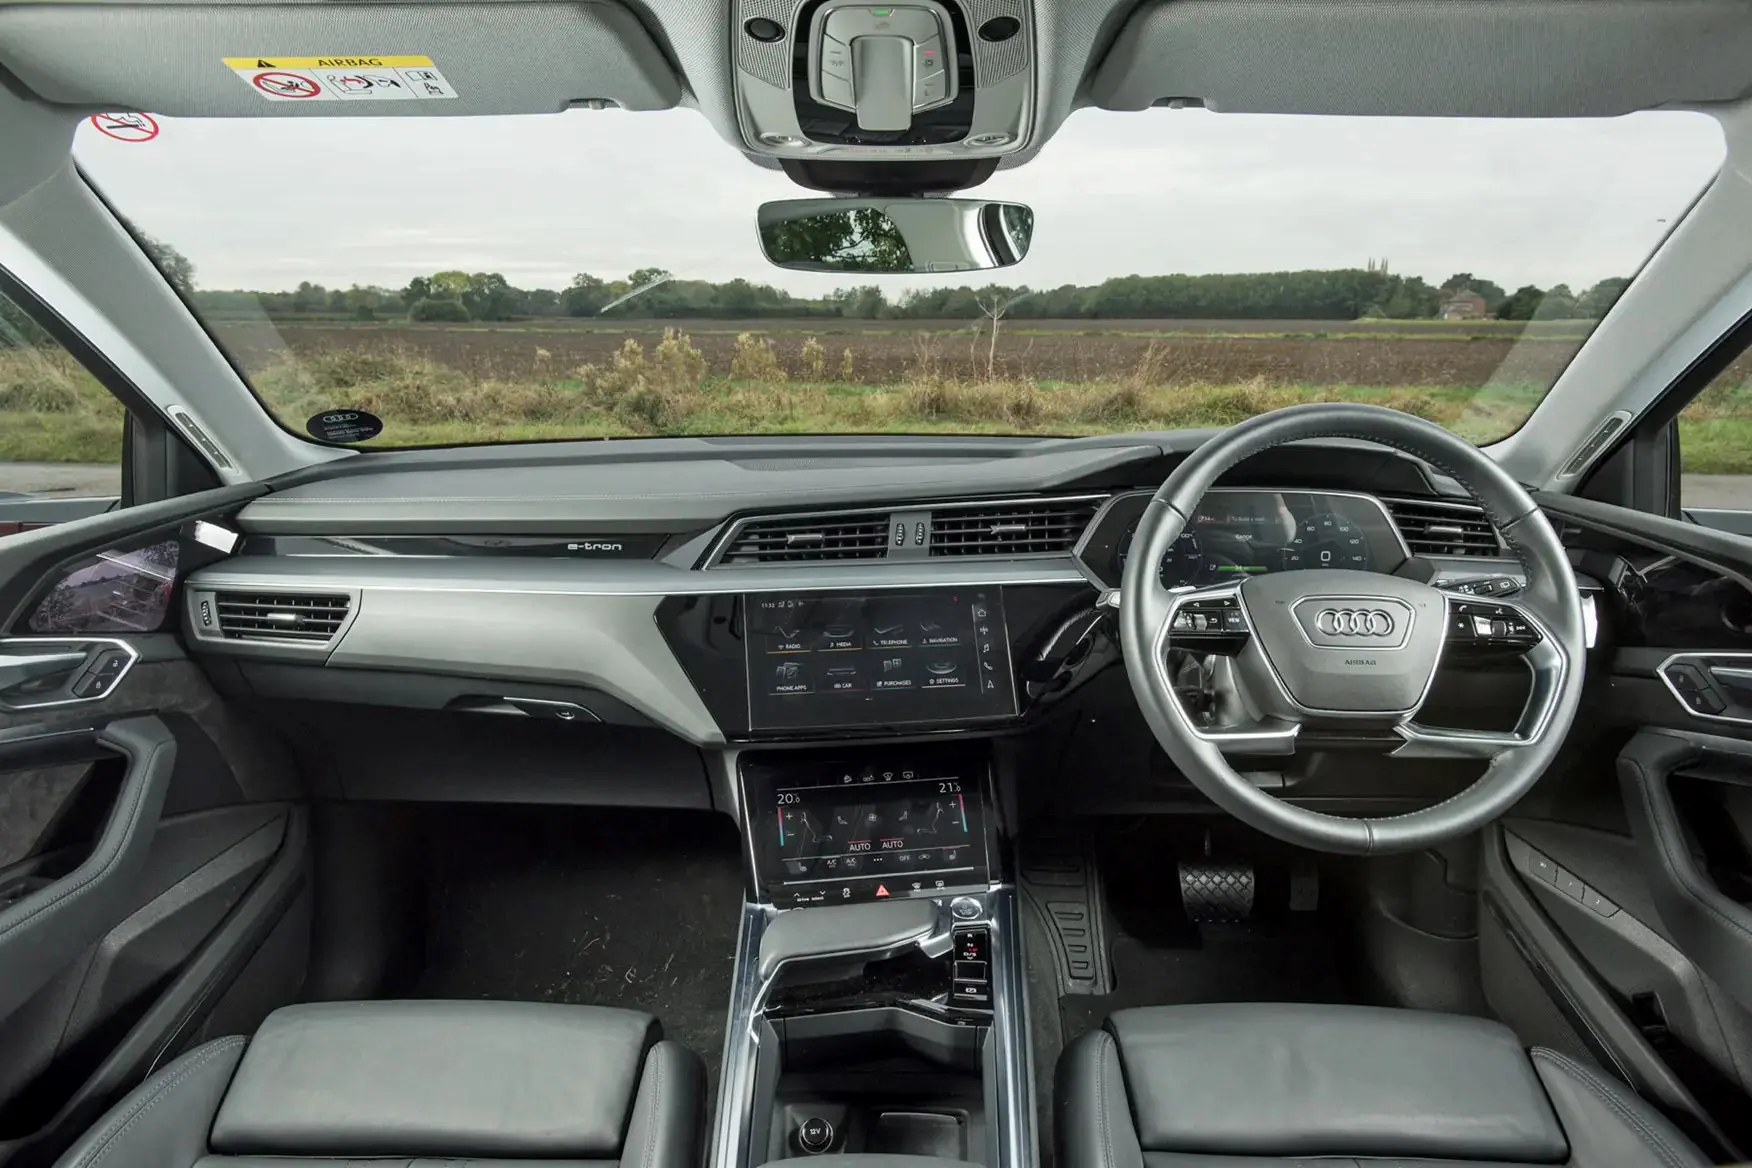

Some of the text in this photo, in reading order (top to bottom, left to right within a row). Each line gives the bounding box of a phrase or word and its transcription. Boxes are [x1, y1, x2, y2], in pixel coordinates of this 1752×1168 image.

[318, 58, 382, 67] AIRBAG
[567, 542, 622, 551] e-tron
[1320, 550, 1332, 562] 0
[849, 843, 871, 851] AUTO
[882, 840, 904, 849] AUTO
[809, 1127, 821, 1136] 12V
